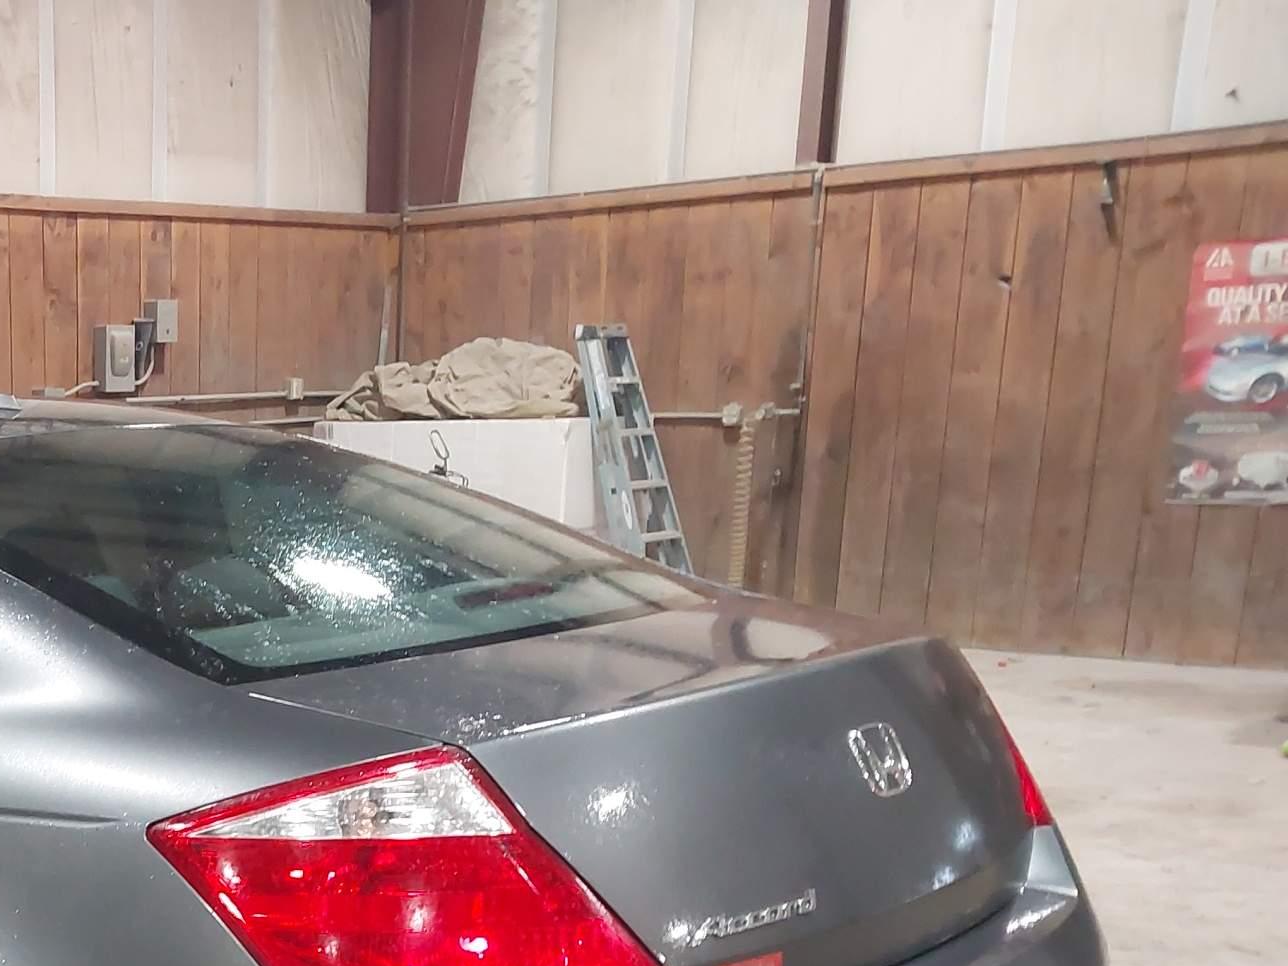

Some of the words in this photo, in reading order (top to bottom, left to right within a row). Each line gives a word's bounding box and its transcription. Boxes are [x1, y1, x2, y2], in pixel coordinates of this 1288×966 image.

[1207, 284, 1288, 307] QUALITY
[1219, 304, 1243, 325] AT
[1246, 303, 1261, 323] A
[688, 888, 817, 947] Accord
